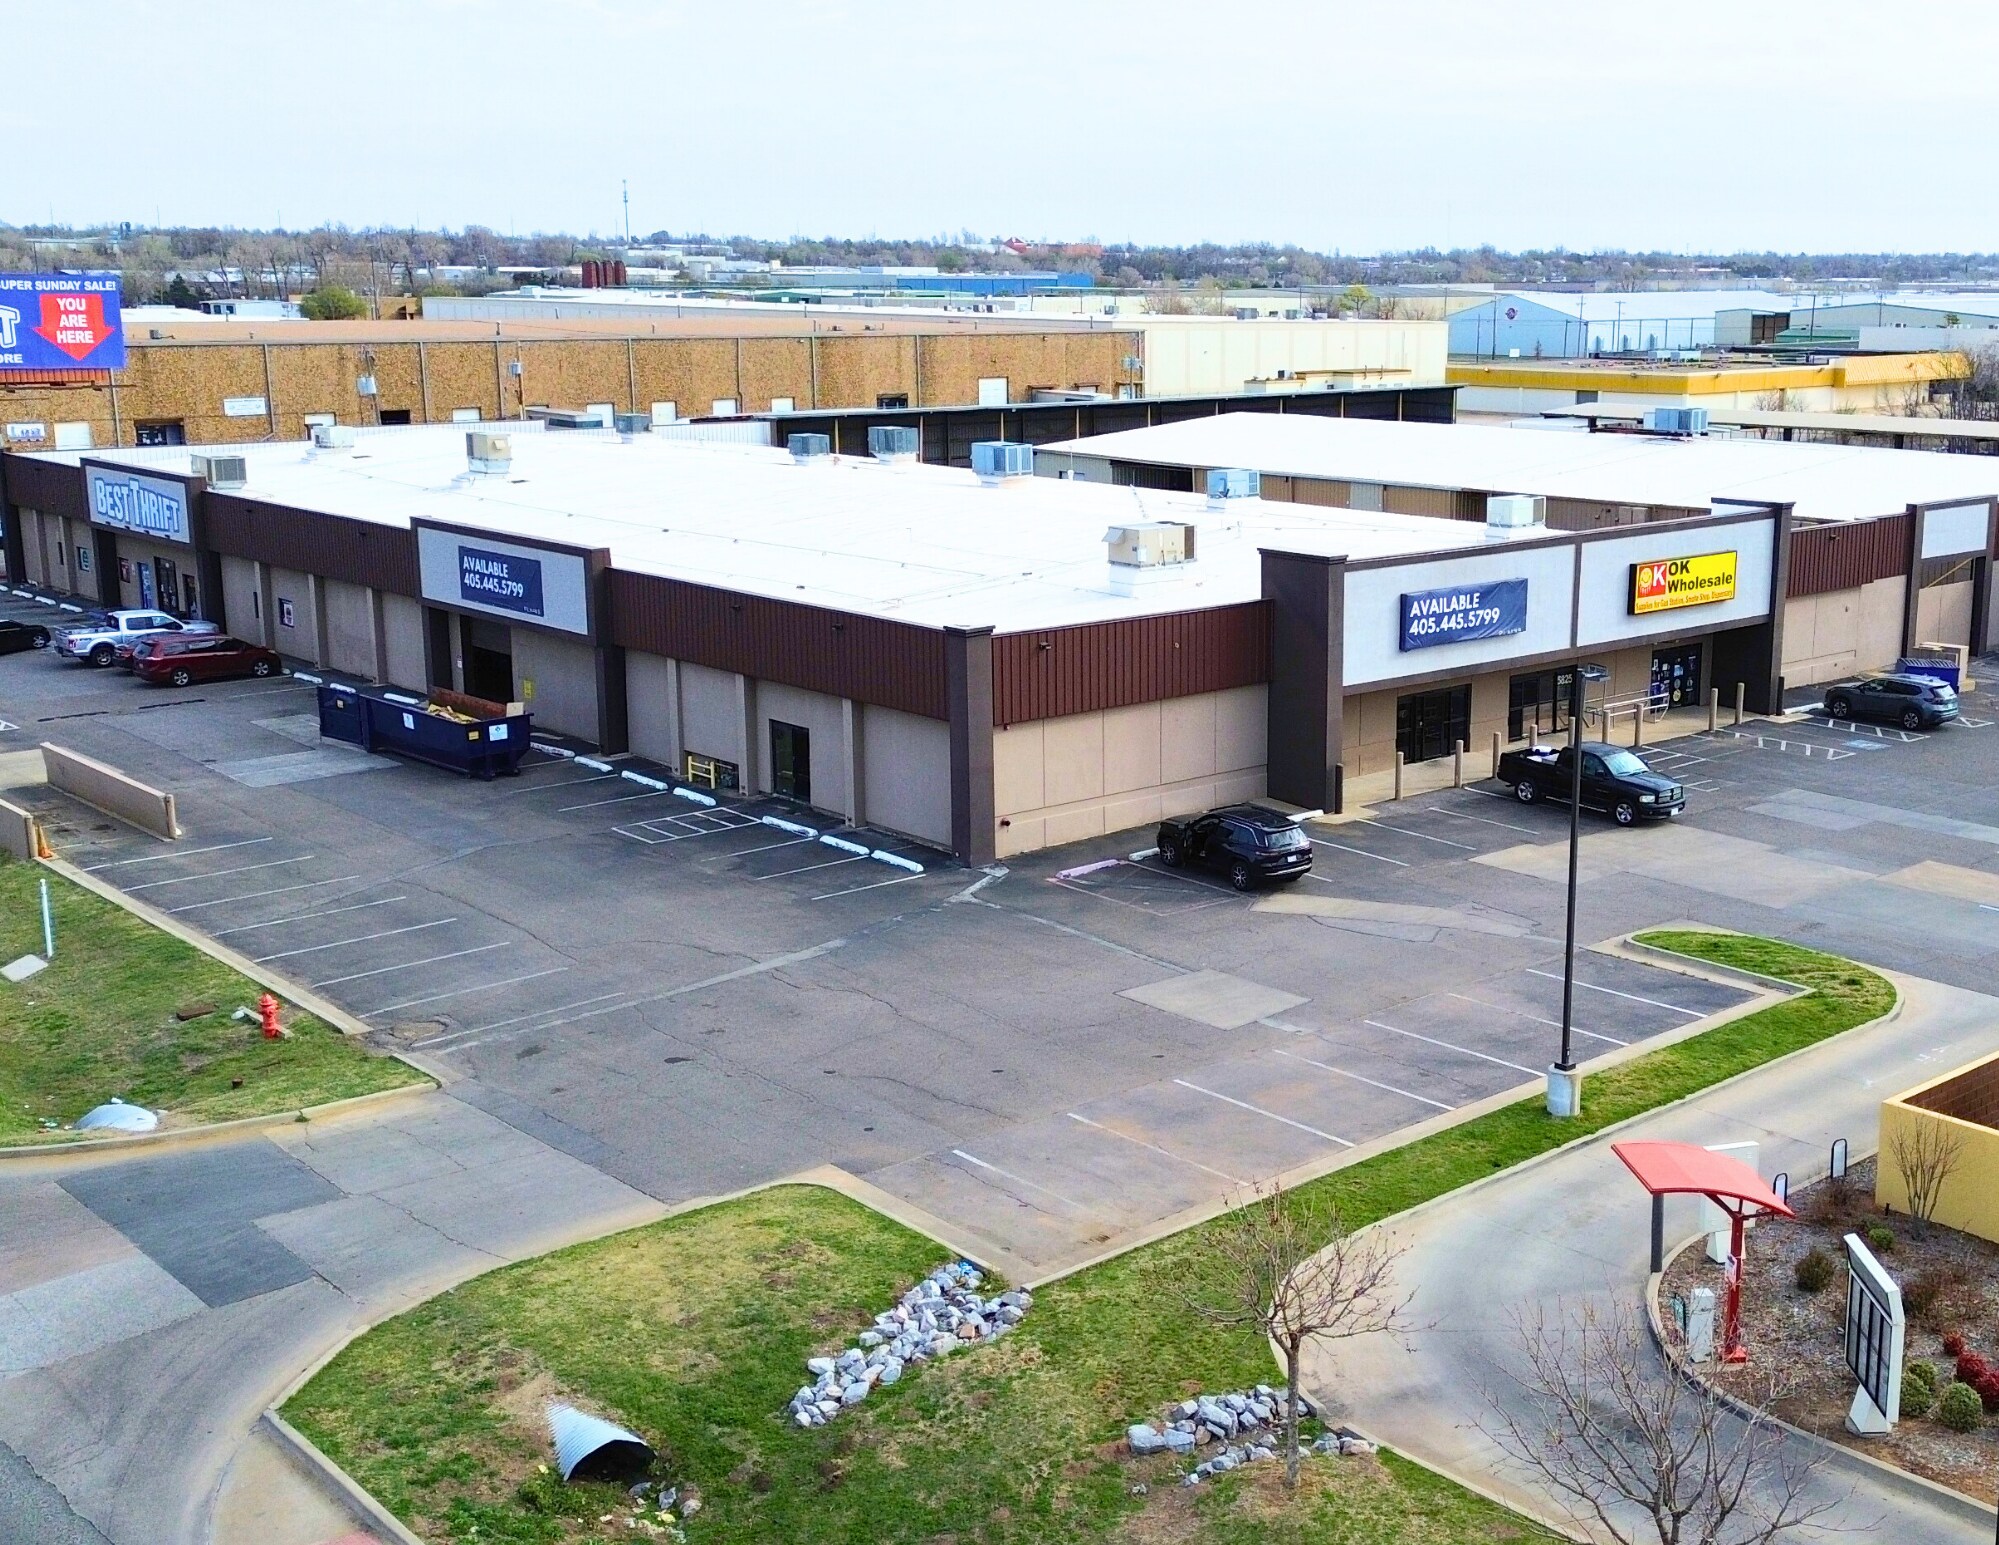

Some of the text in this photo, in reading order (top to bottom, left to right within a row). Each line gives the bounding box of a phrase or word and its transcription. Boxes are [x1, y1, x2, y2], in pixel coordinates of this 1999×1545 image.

[0, 280, 116, 291] UPER SUNDAY SALE!
[56, 297, 86, 311] YOU
[60, 315, 88, 328] ARE
[56, 331, 94, 344] HERE
[95, 478, 179, 532] BEST THRIFT
[463, 556, 508, 578] AVAILABLE
[1668, 560, 1691, 576] OK
[464, 572, 524, 598] 405.445.5799
[1668, 572, 1733, 594] Wholesale
[1410, 592, 1481, 617] AVAILABLE
[1409, 607, 1500, 636] 405.445.5799
[1557, 673, 1573, 685] 5825
